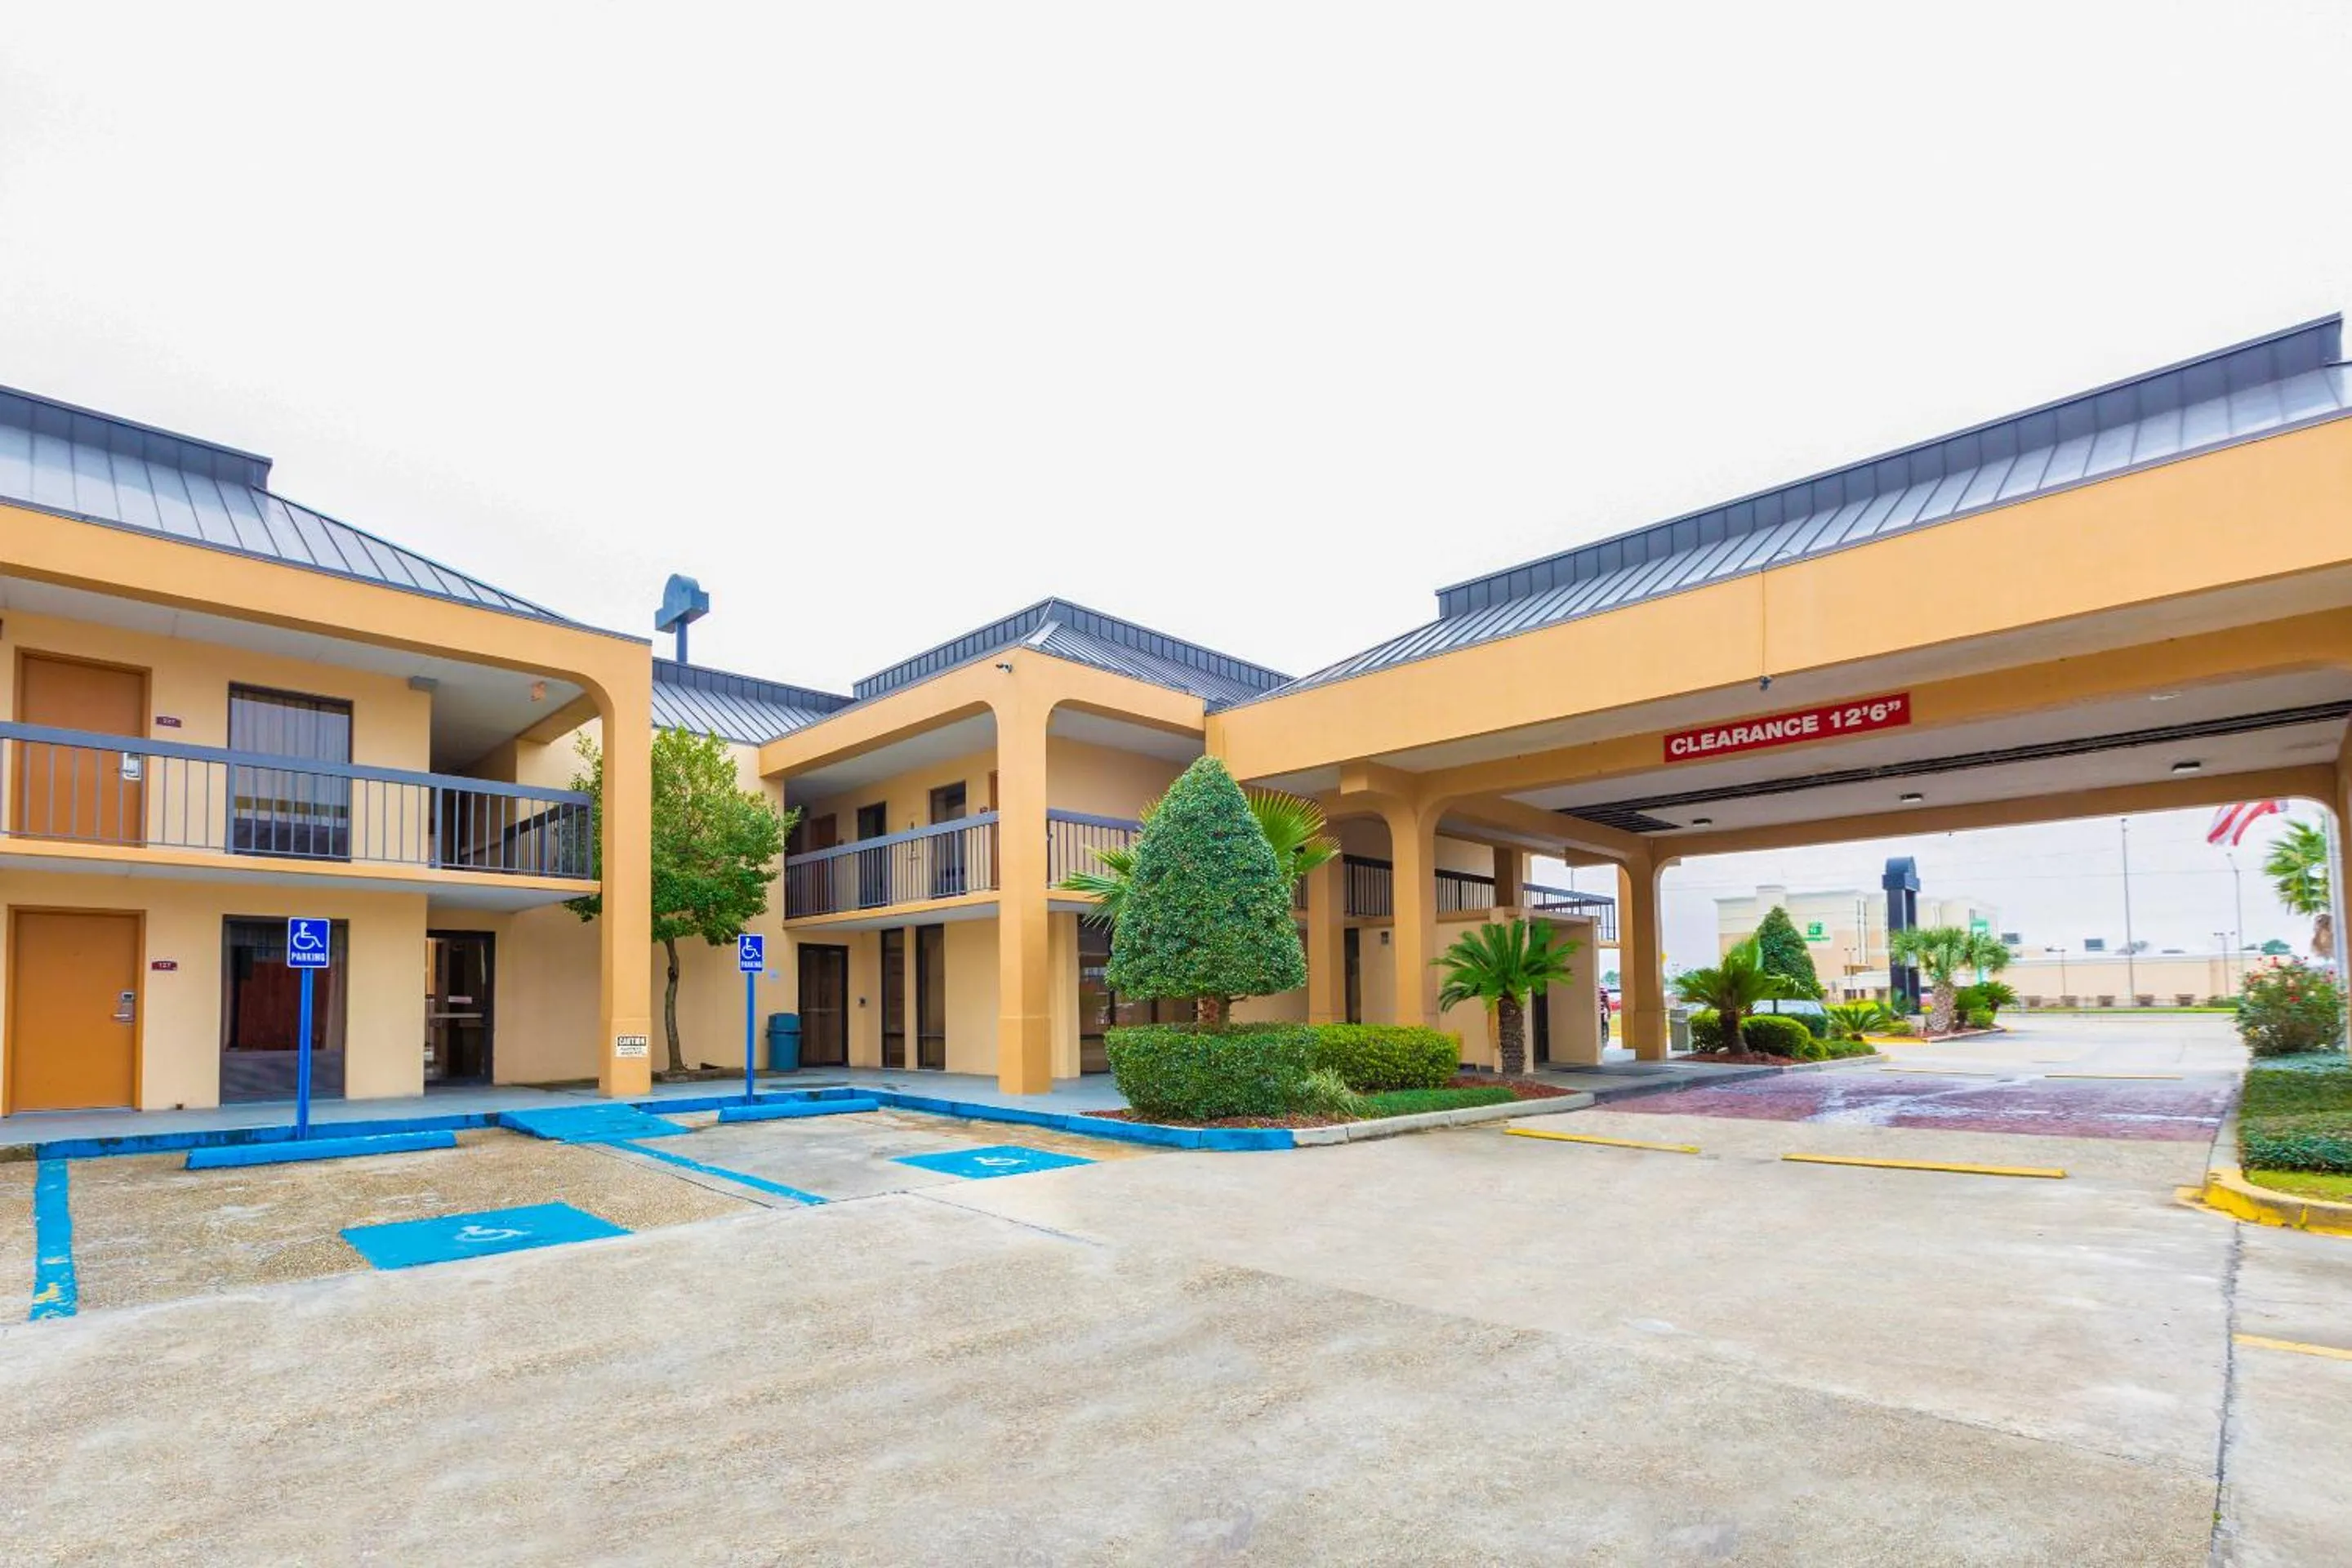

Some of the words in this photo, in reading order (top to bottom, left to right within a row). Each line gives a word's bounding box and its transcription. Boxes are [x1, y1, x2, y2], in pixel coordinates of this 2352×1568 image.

[1671, 715, 1818, 755] CLEARANCE
[292, 952, 325, 962] PARKING
[620, 1037, 645, 1045] CAUTION
